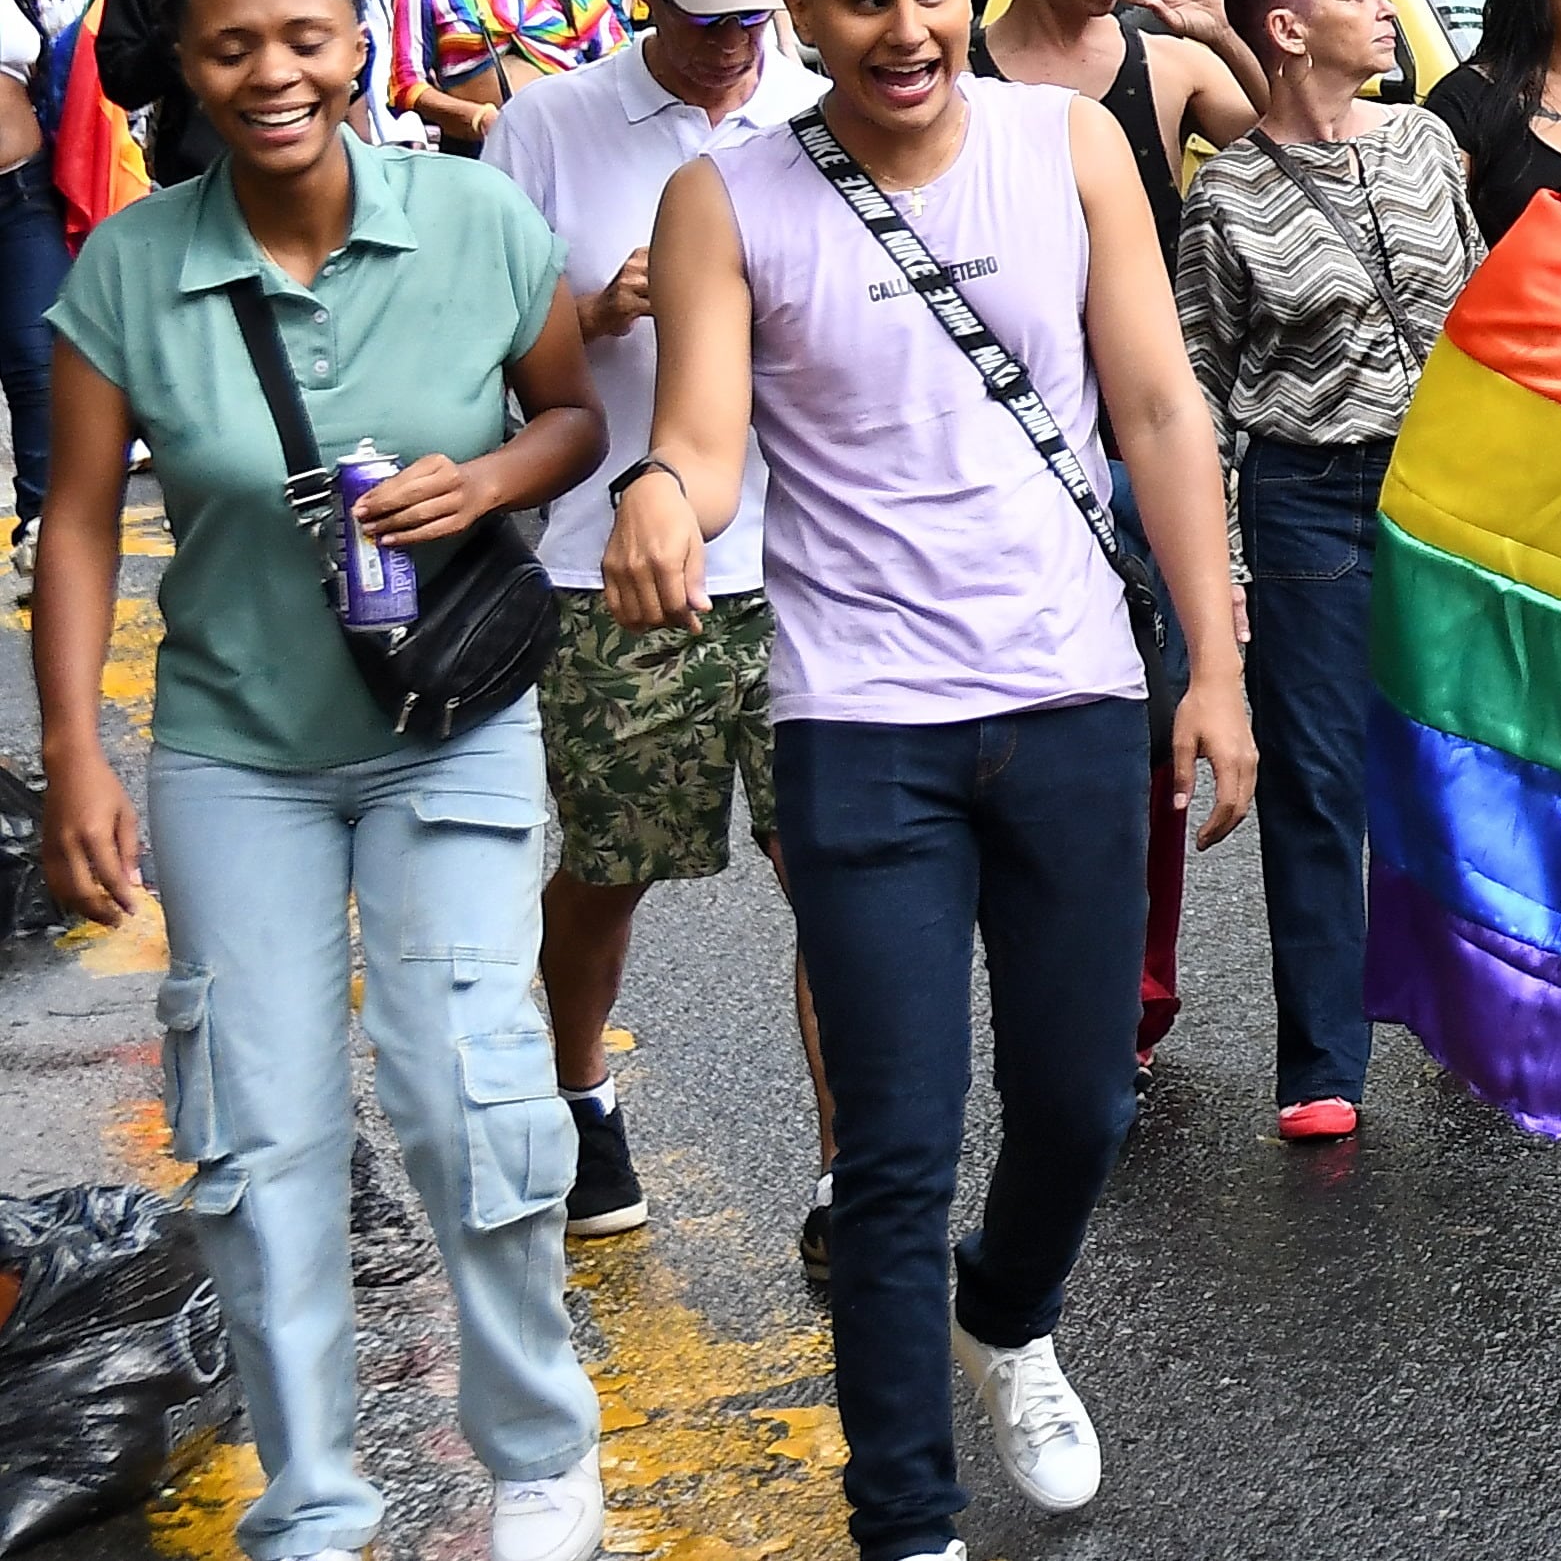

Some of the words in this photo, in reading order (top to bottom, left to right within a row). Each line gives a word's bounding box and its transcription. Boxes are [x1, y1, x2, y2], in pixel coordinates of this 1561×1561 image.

[799, 123, 850, 169] NIKE
[833, 174, 896, 221] NIKE
[879, 229, 942, 280] NIKE
[922, 285, 984, 337] NIKE
[1009, 390, 1060, 444] NIKE
[1050, 448, 1091, 499] NIKE
[1087, 505, 1117, 553] NIKE
